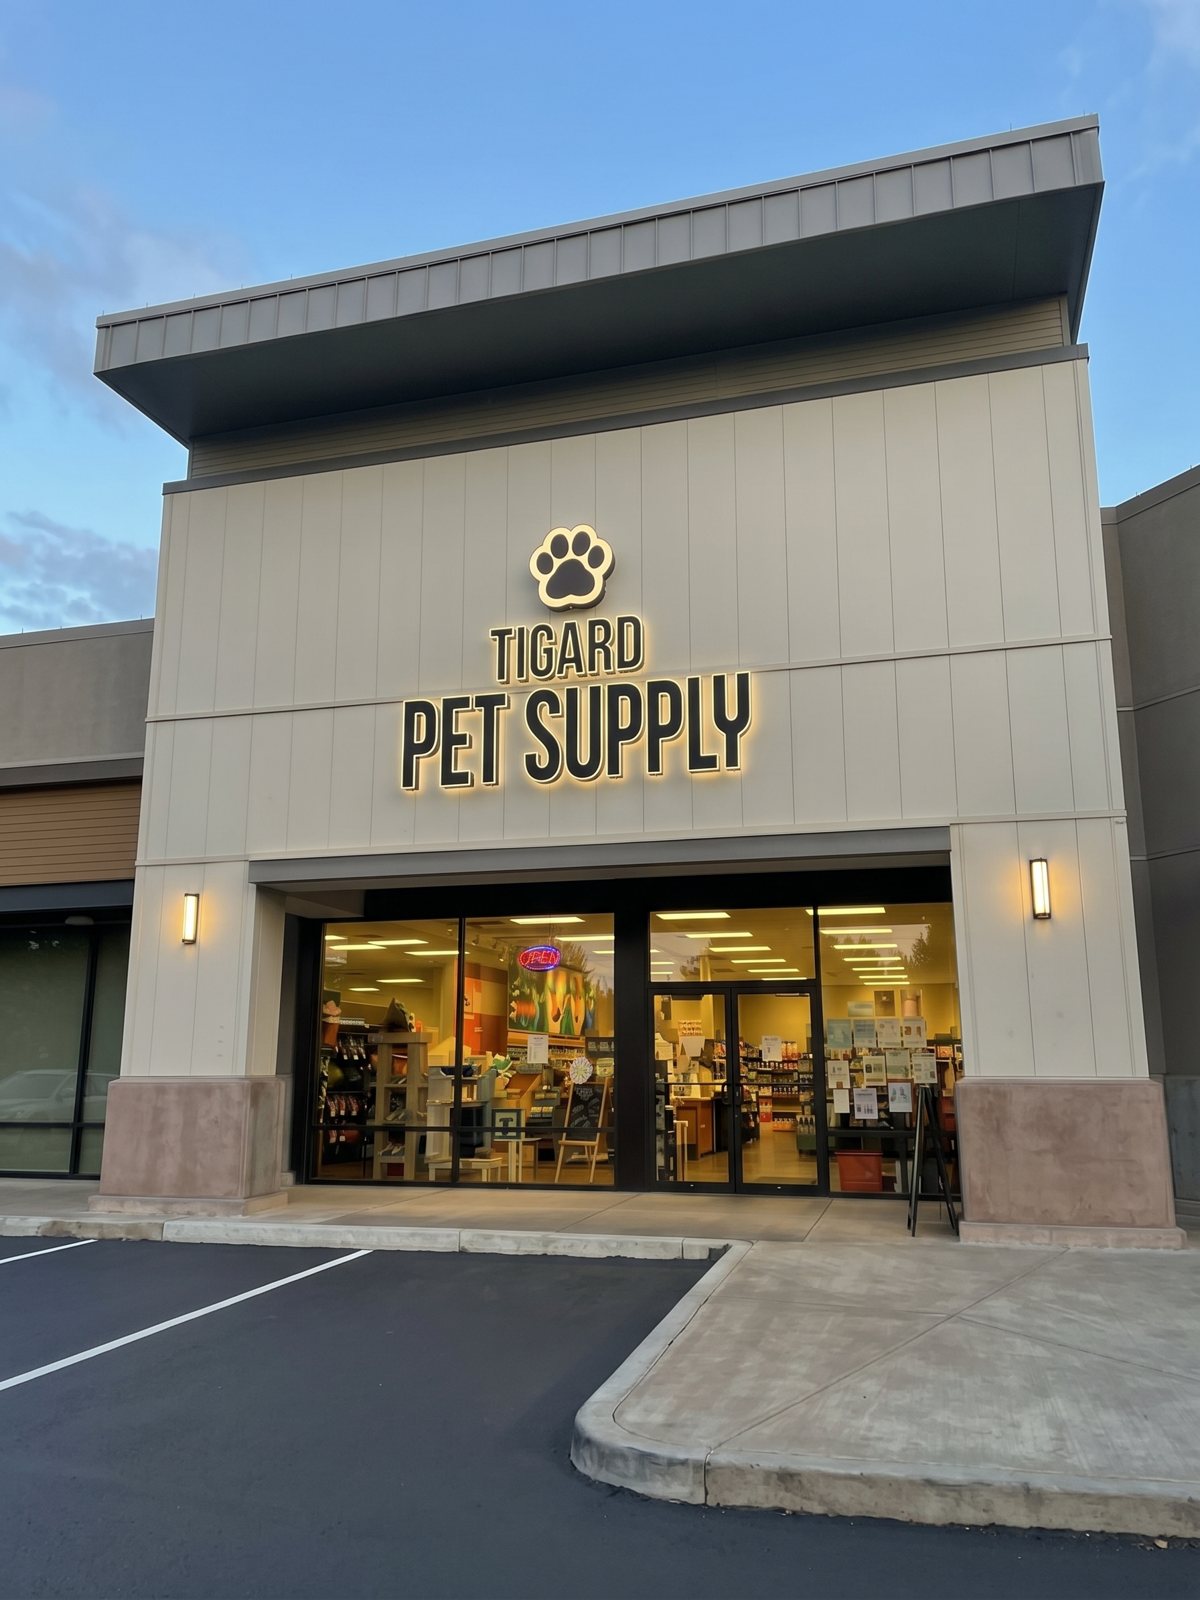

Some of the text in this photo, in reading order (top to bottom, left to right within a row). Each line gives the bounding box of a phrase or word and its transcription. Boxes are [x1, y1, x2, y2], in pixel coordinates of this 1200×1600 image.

[490, 615, 644, 682] TIGARD
[401, 671, 751, 789] PET SUPPLY
[520, 950, 558, 965] OPEN
